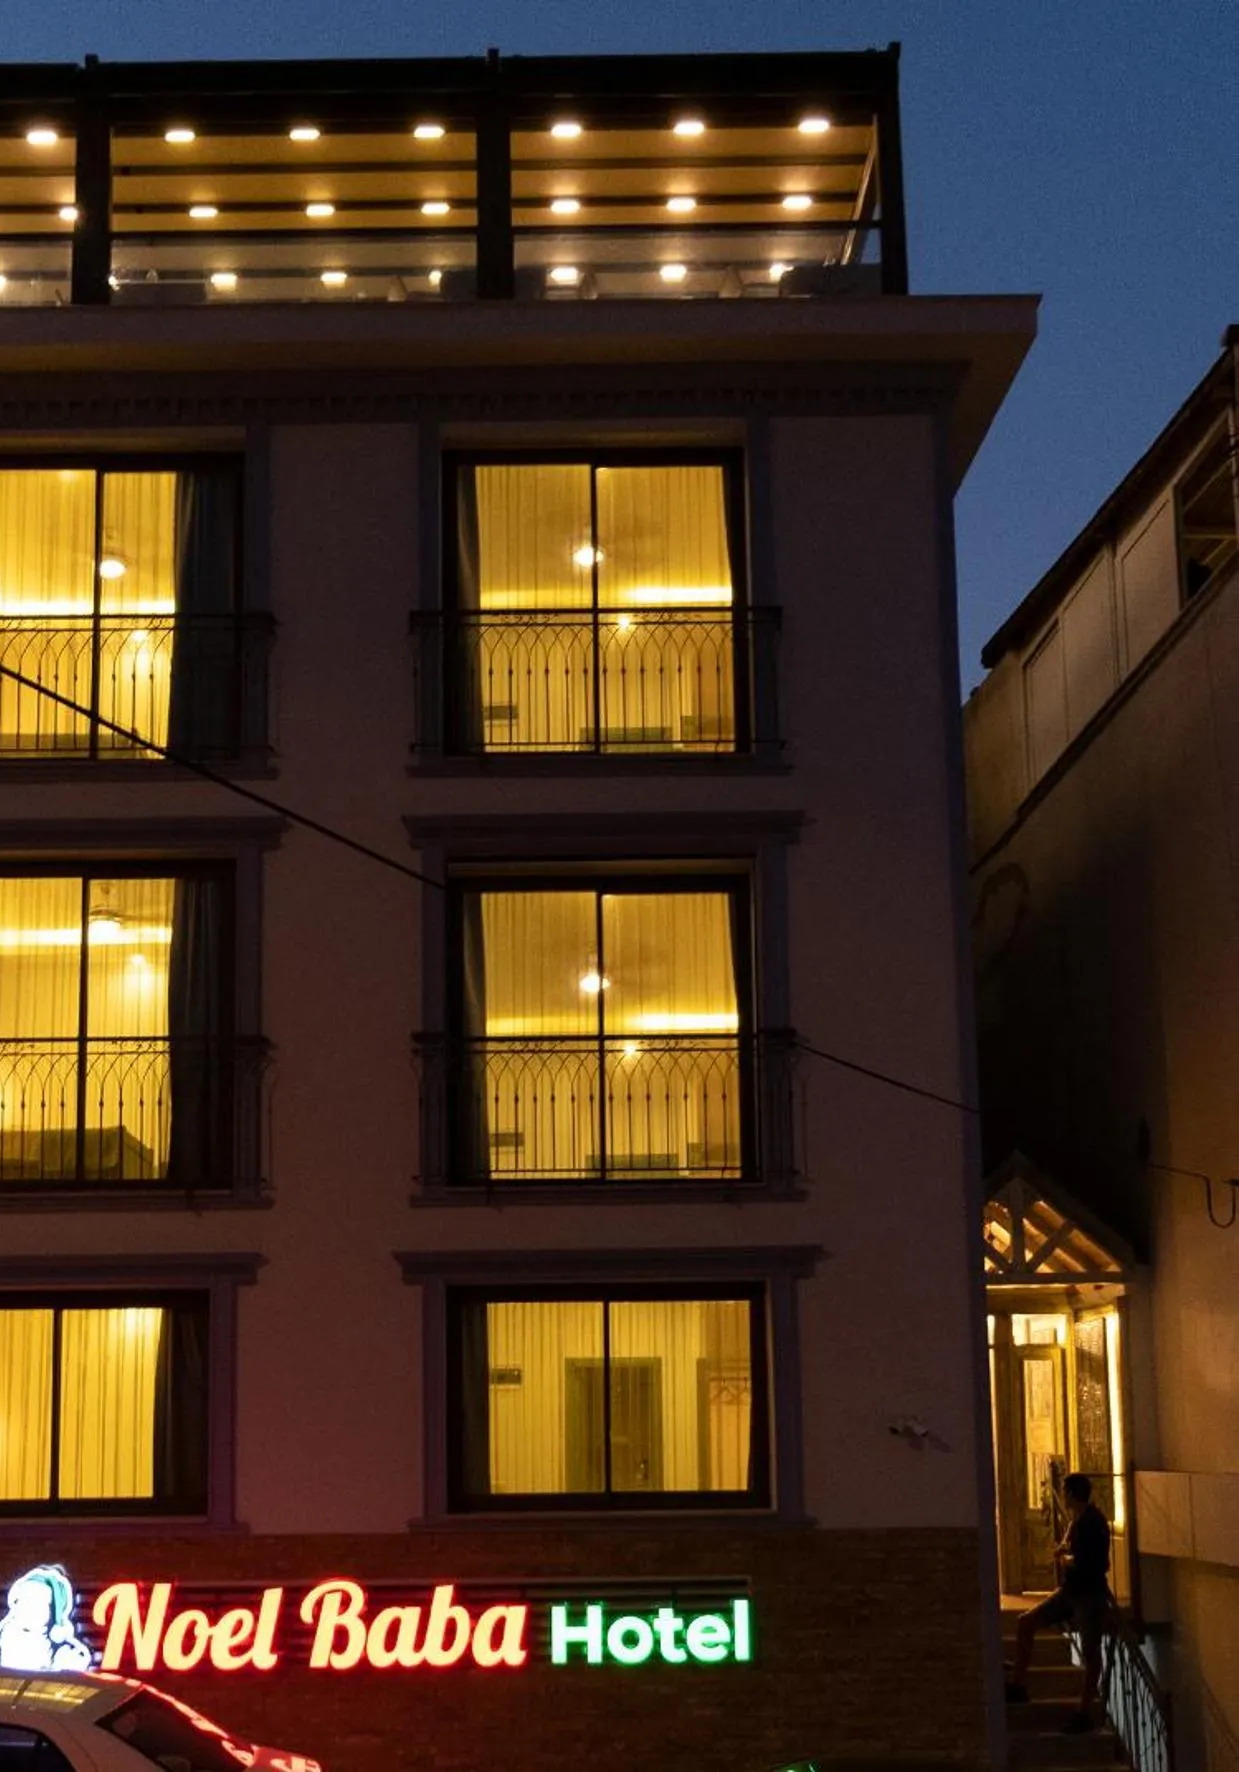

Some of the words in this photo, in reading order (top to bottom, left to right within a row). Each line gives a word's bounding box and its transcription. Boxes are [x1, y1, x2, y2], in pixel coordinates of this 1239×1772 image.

[92, 1582, 283, 1671] Noel
[299, 1580, 528, 1670] Baba
[551, 1599, 751, 1665] Hotel
